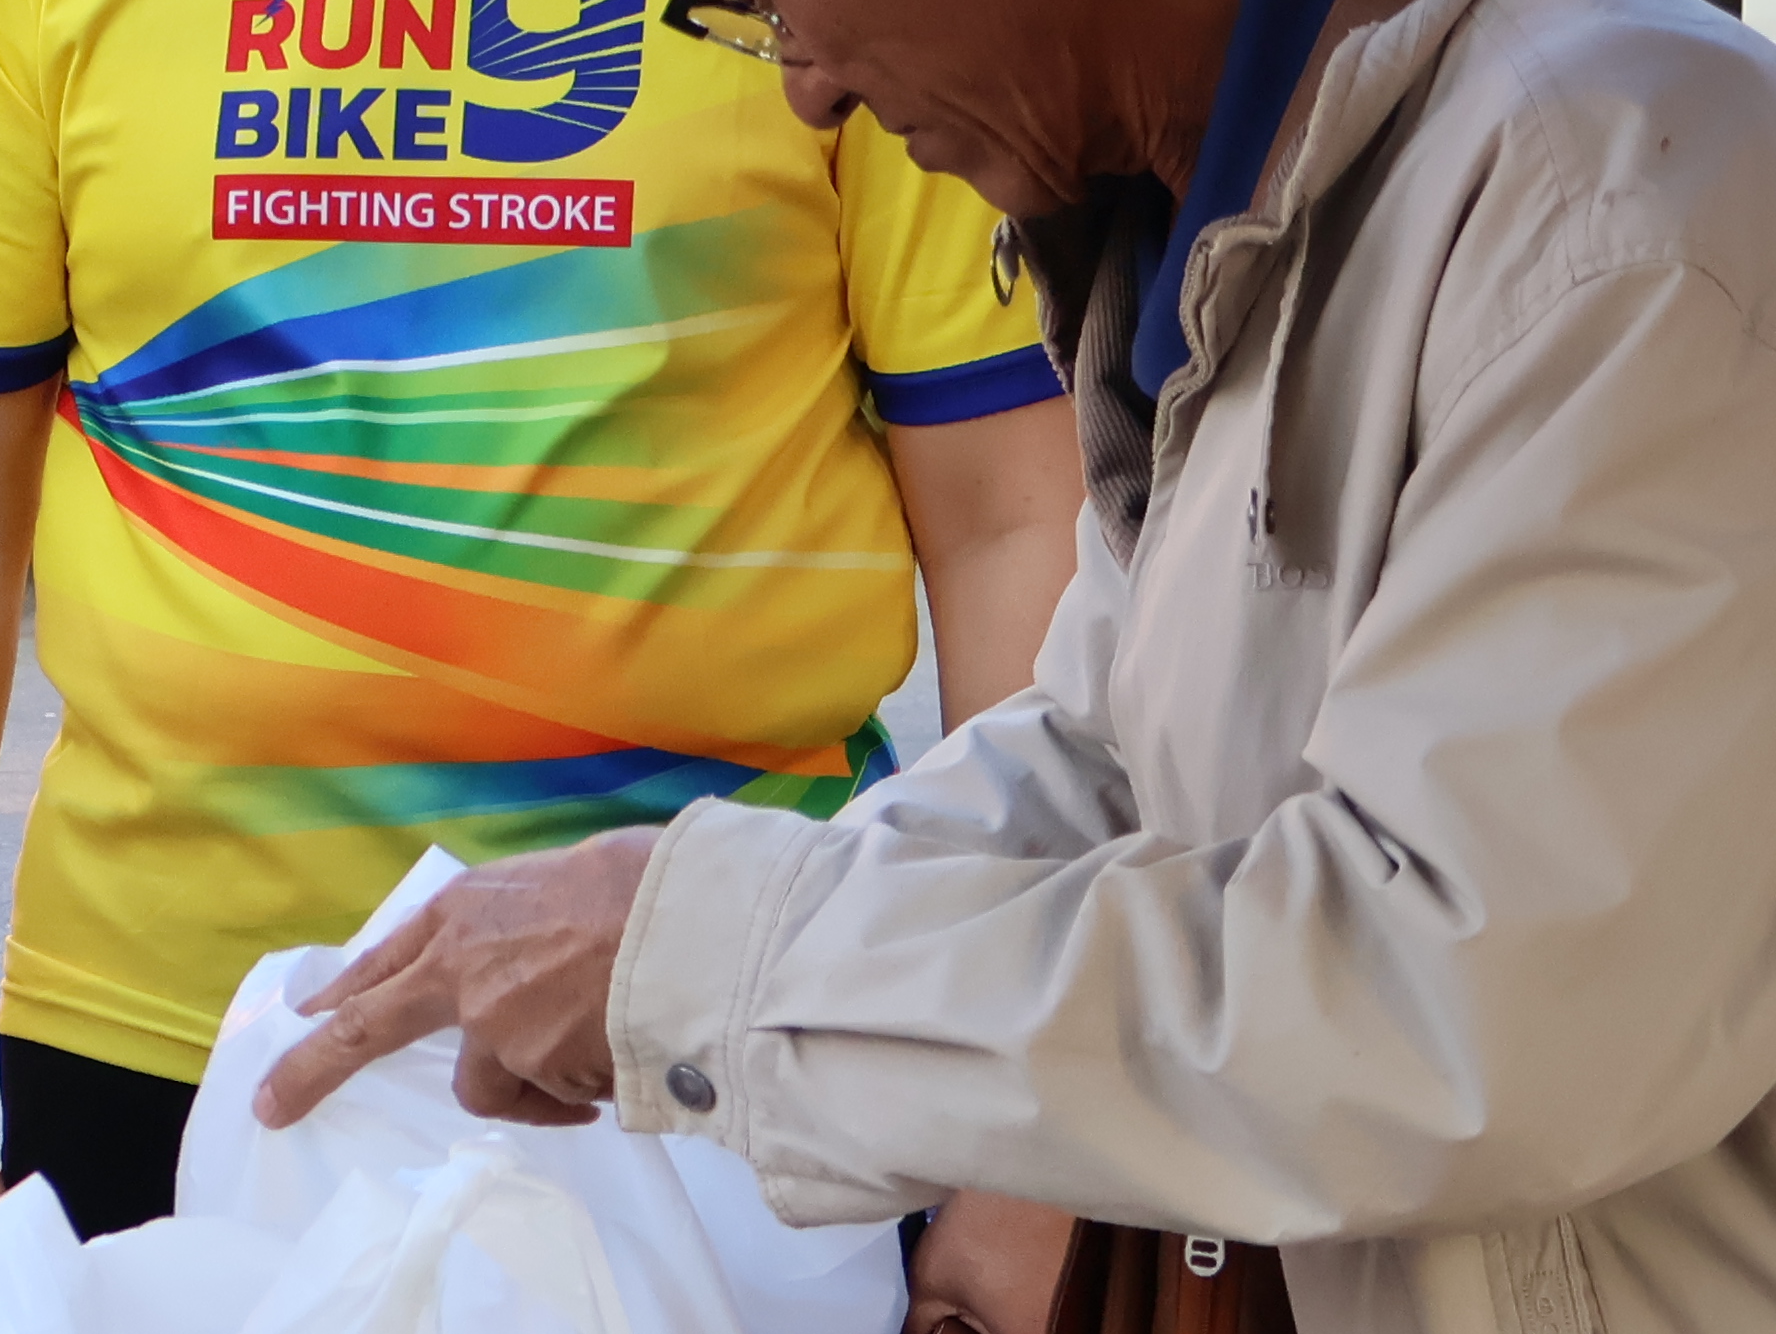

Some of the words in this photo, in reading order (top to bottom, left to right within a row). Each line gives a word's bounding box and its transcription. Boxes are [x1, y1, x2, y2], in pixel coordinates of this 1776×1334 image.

[214, 87, 452, 161] BIKE
[226, 189, 435, 229] FIGHTING
[448, 192, 616, 232] STROKE
